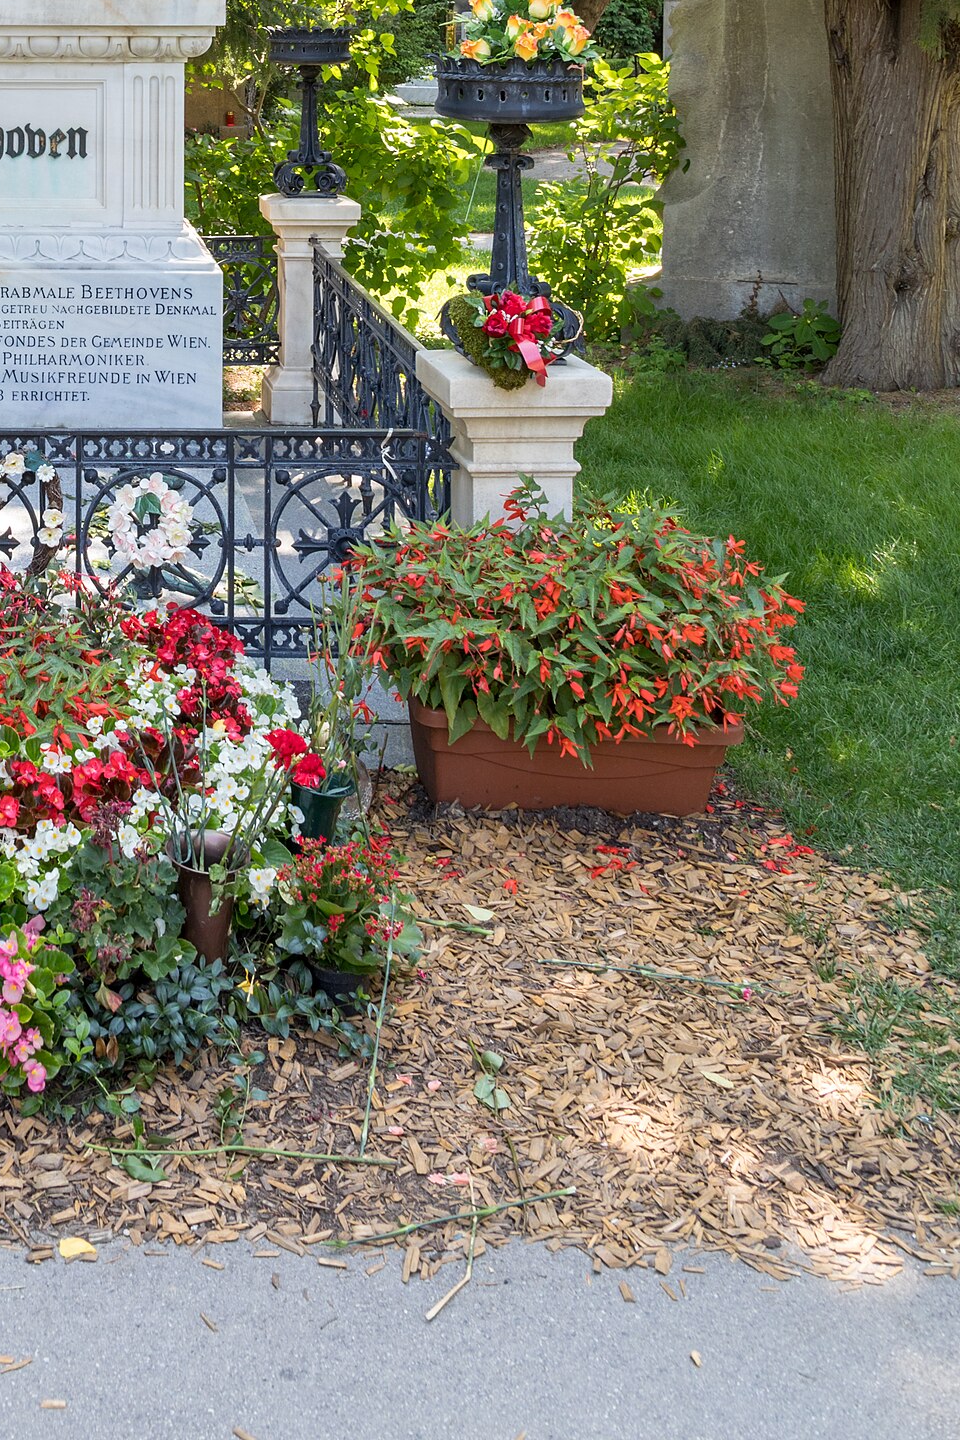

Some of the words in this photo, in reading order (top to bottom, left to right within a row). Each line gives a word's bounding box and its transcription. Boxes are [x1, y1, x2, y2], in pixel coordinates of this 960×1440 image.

[80, 283, 193, 301] BEETHOVENS
[0, 304, 48, 315] GETREU
[51, 304, 151, 316] NACHGEBILDETE
[154, 302, 217, 316] DENKMAL
[60, 336, 88, 348] DER
[91, 334, 165, 349] GEMEINDE
[1, 368, 131, 385] MUSIKFREUNDE
[136, 373, 151, 385] IN
[153, 369, 197, 385] WIEN
[11, 390, 90, 402] ERRICHTET.
